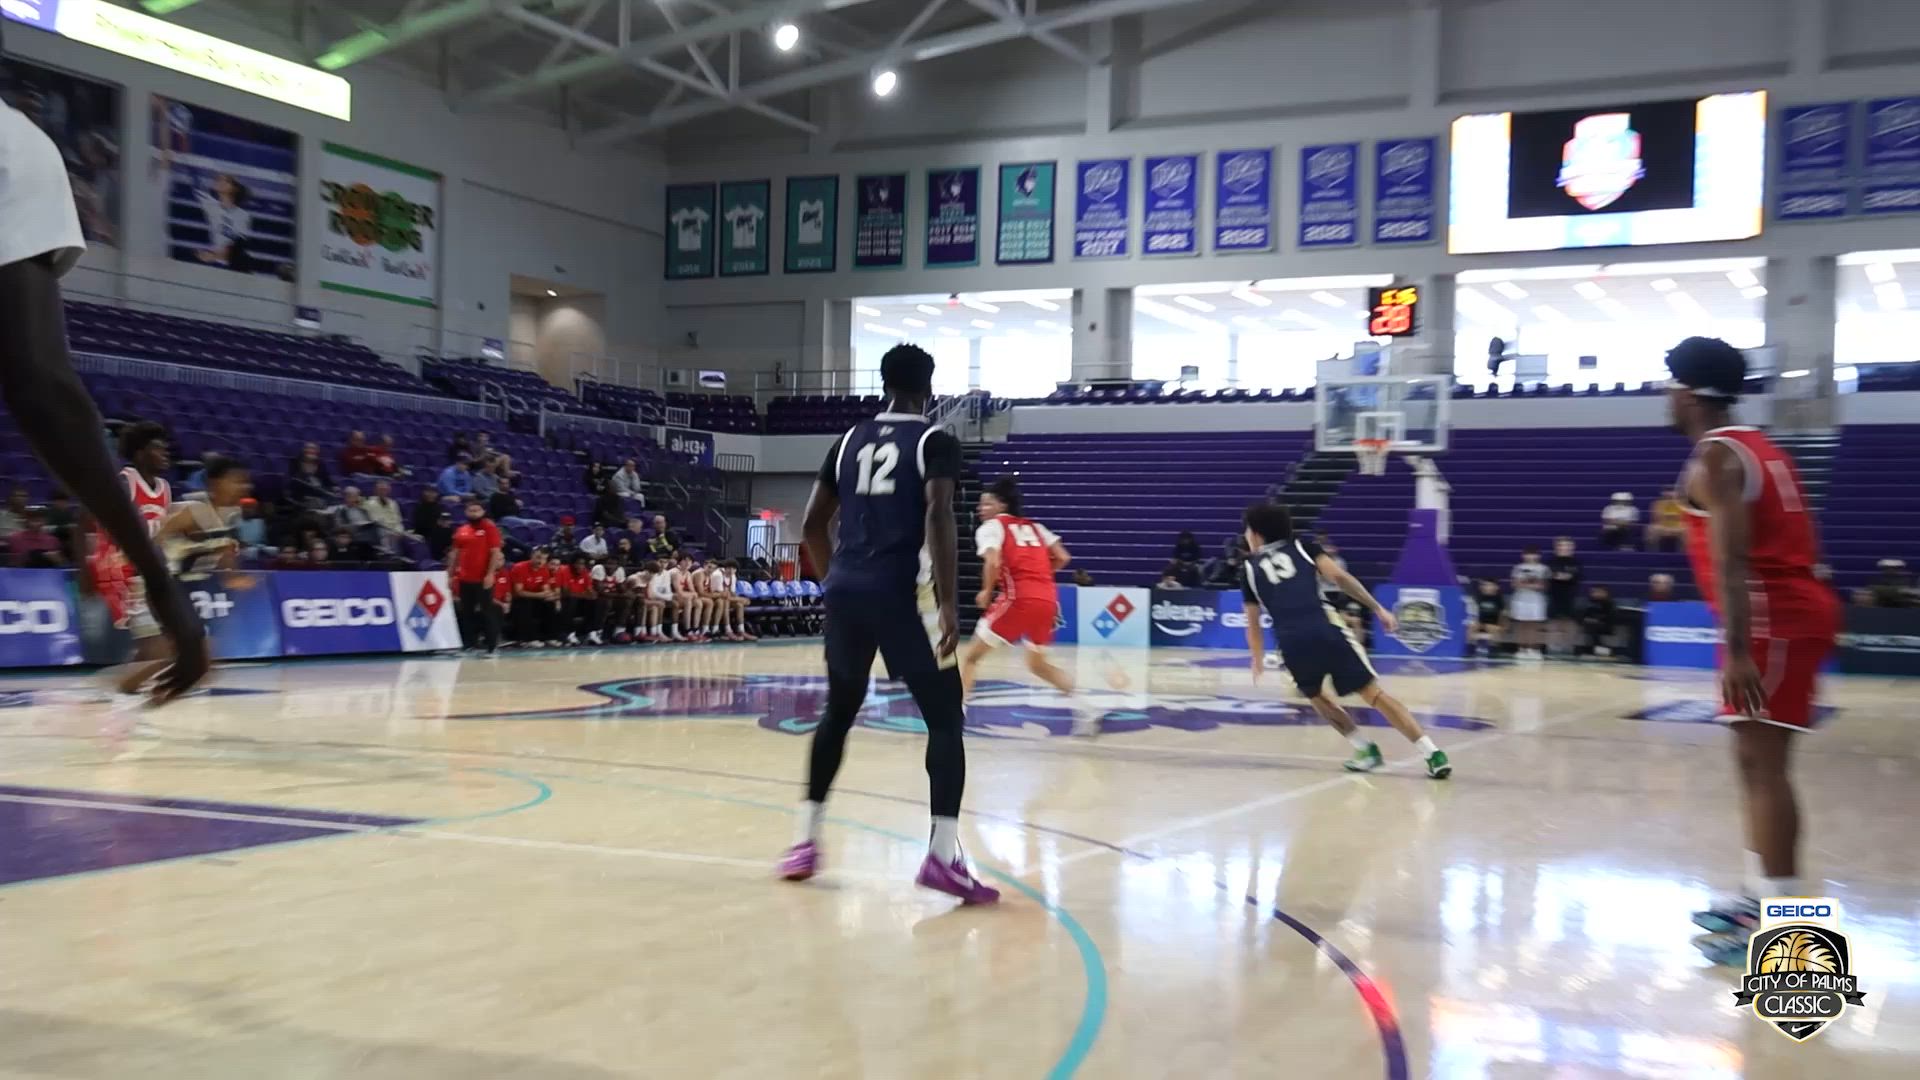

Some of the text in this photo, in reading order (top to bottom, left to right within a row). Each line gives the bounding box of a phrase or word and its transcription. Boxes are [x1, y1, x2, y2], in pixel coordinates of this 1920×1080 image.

[855, 441, 900, 496] 12
[1259, 552, 1297, 584] 13
[281, 598, 395, 627] GEICO
[1152, 600, 1216, 622] alexa+
